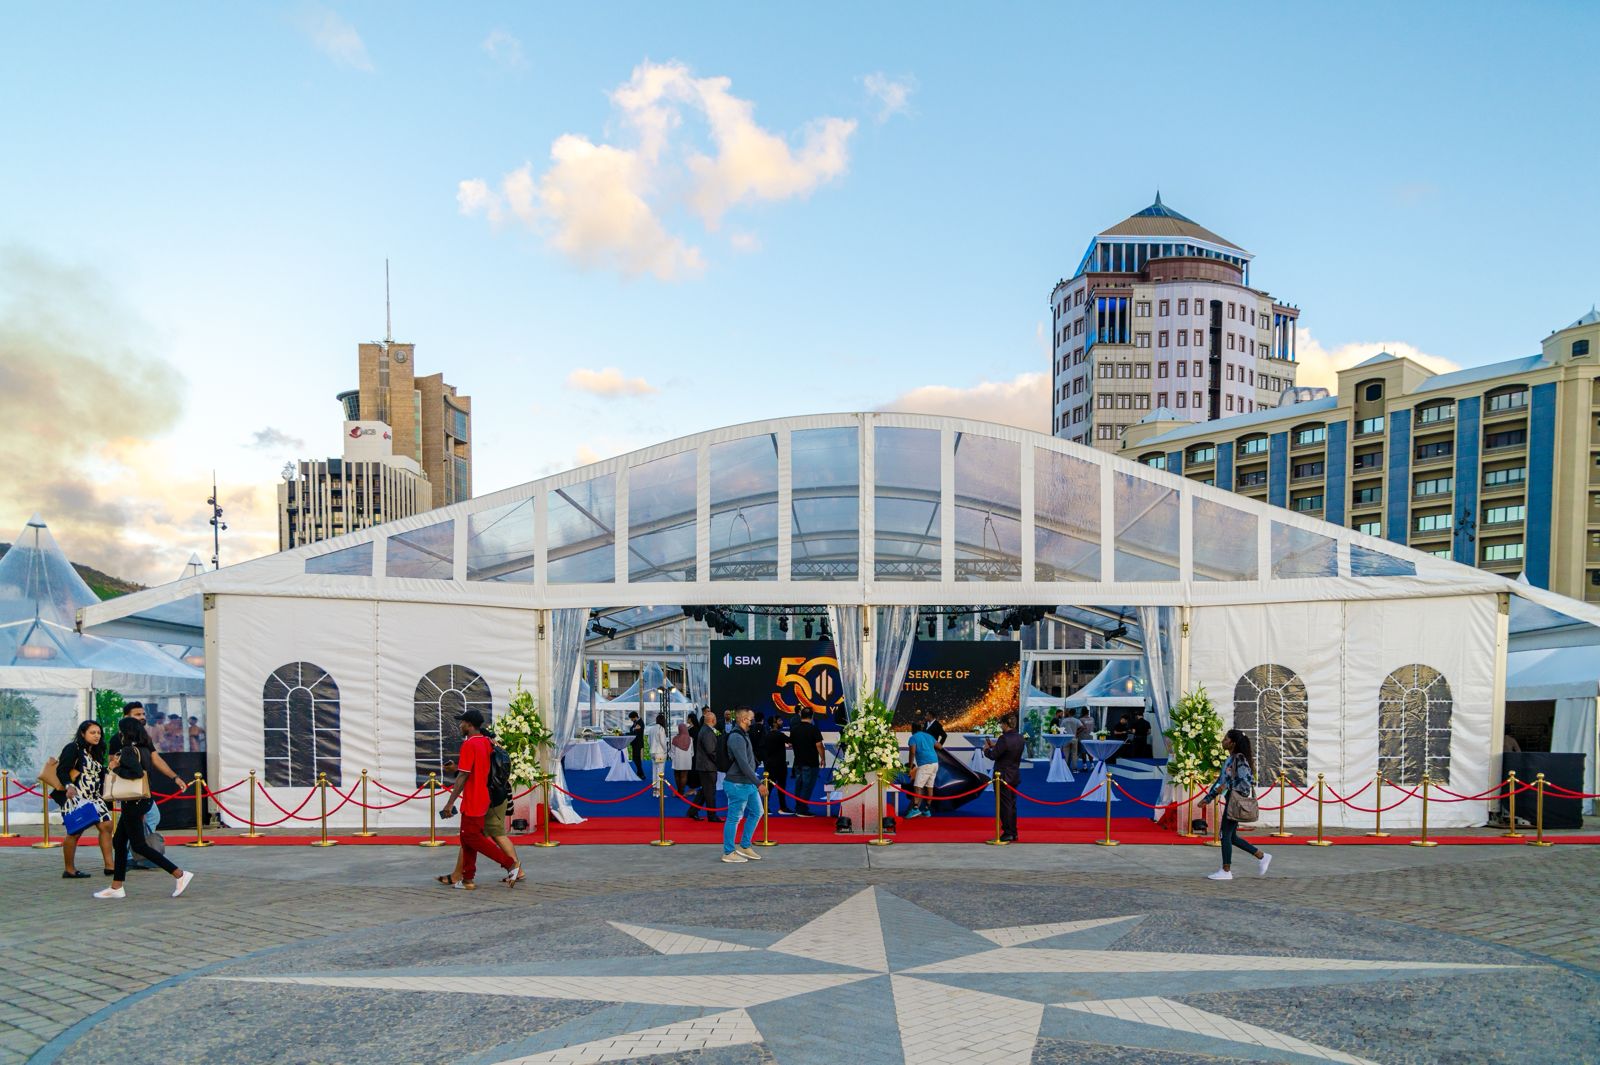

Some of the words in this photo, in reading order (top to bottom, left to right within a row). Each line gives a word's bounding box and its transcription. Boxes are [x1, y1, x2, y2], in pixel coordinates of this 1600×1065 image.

[735, 656, 761, 665] SBM
[908, 670, 952, 679] SERVICE
[955, 670, 970, 679] OF
